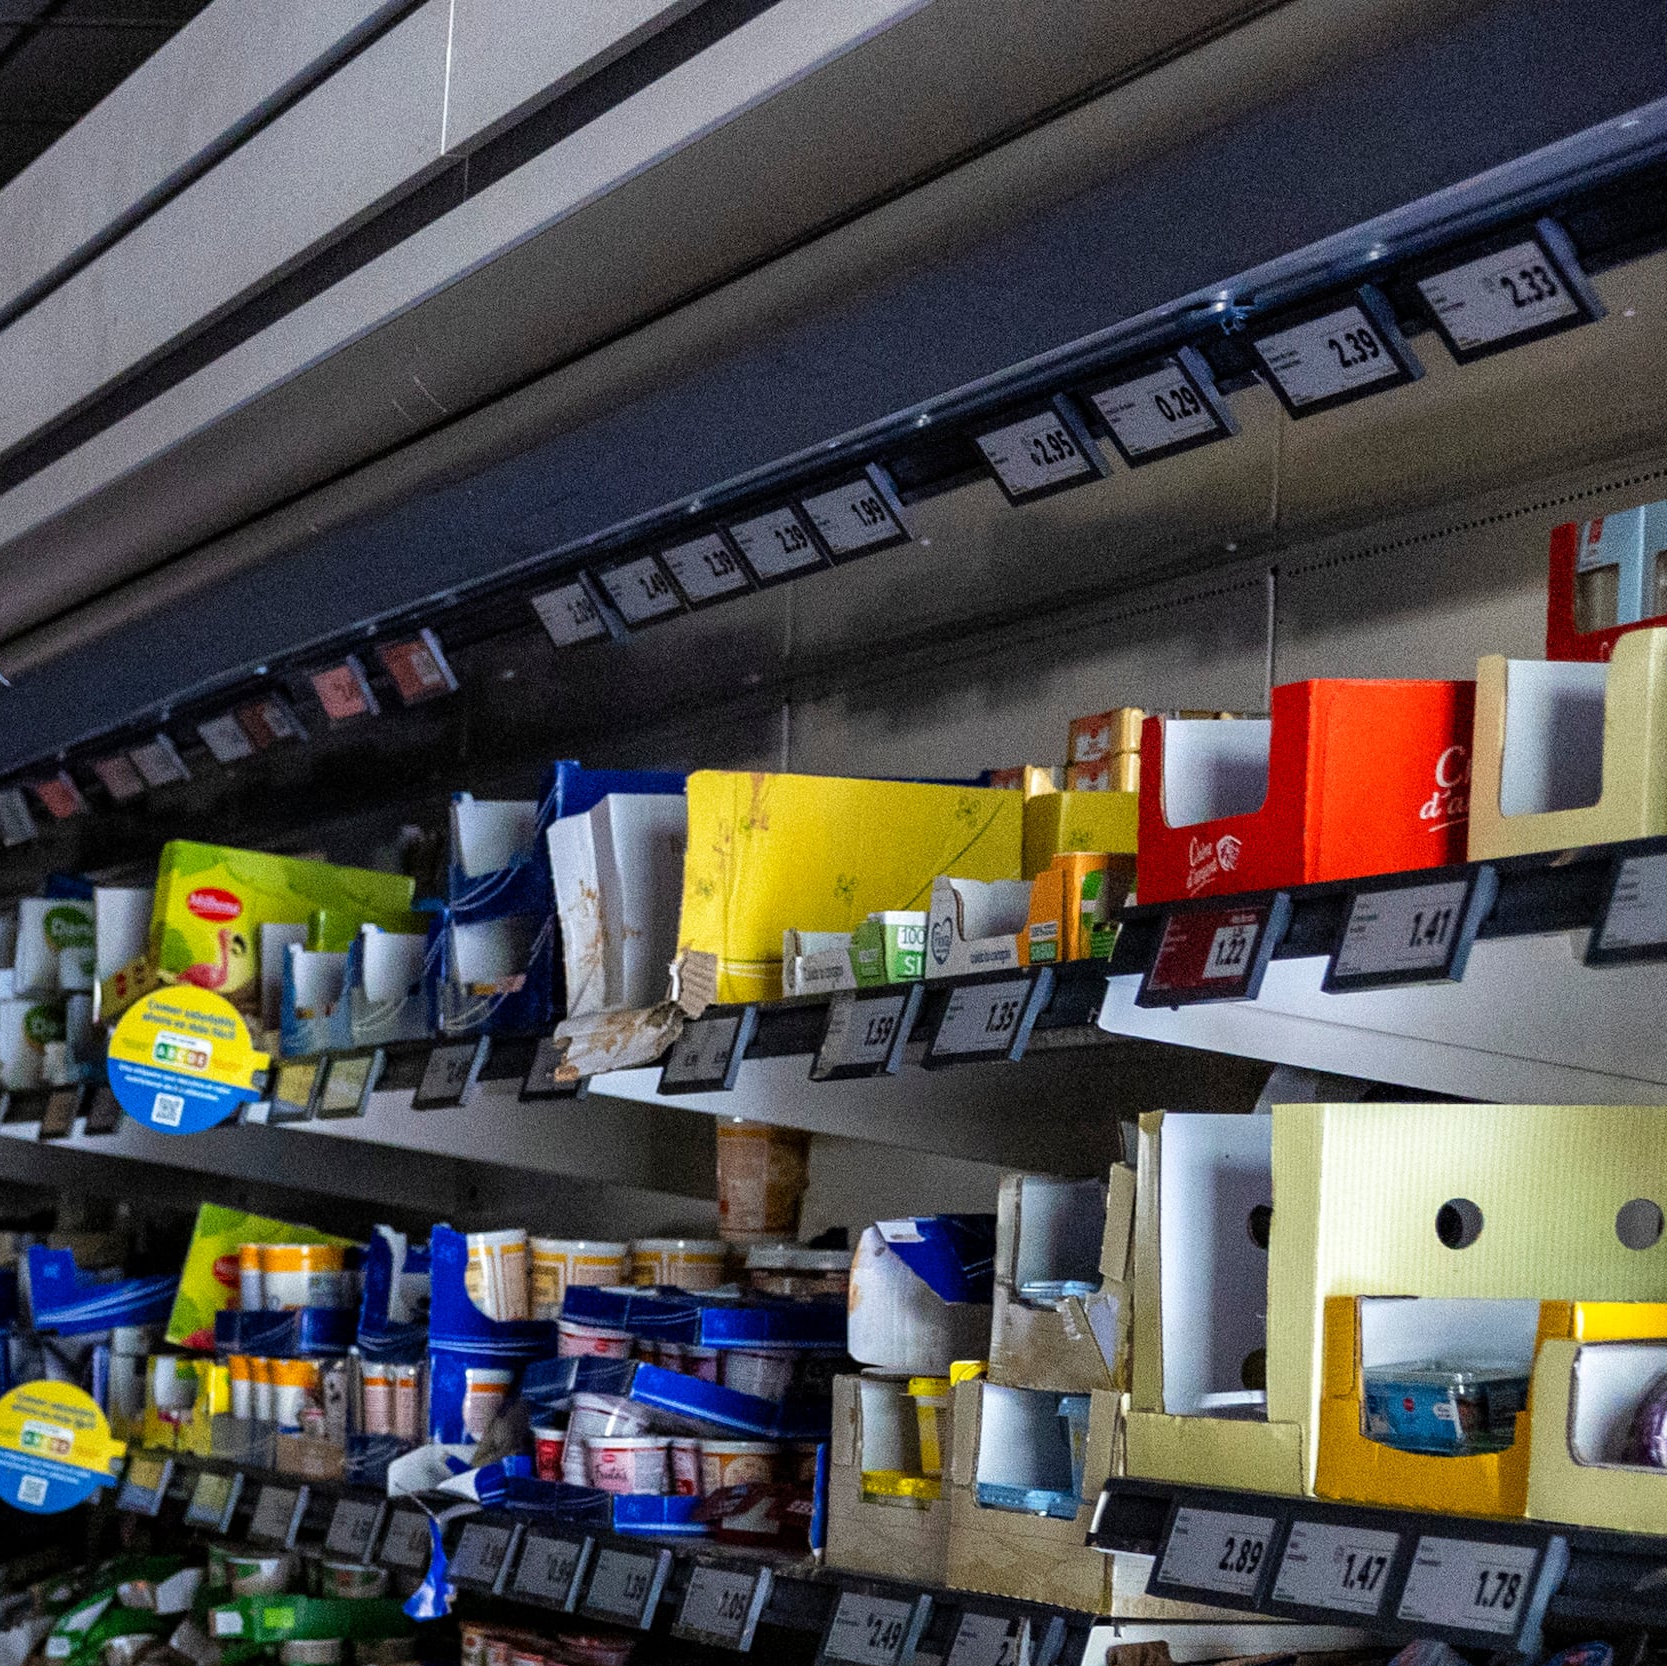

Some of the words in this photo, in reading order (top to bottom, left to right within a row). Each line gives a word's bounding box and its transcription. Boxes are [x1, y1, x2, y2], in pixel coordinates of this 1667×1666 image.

[1499, 266, 1553, 308] 2.33
[1327, 328, 1381, 368] 2.39
[1155, 386, 1202, 423] 0.29
[1436, 745, 1469, 788] C
[1405, 908, 1451, 948] 1.41
[983, 1001, 1020, 1033] 1.35
[1218, 1537, 1264, 1574] 2.89
[1341, 1553, 1386, 1591] 1.47
[1473, 1570, 1522, 1610] 1.78
